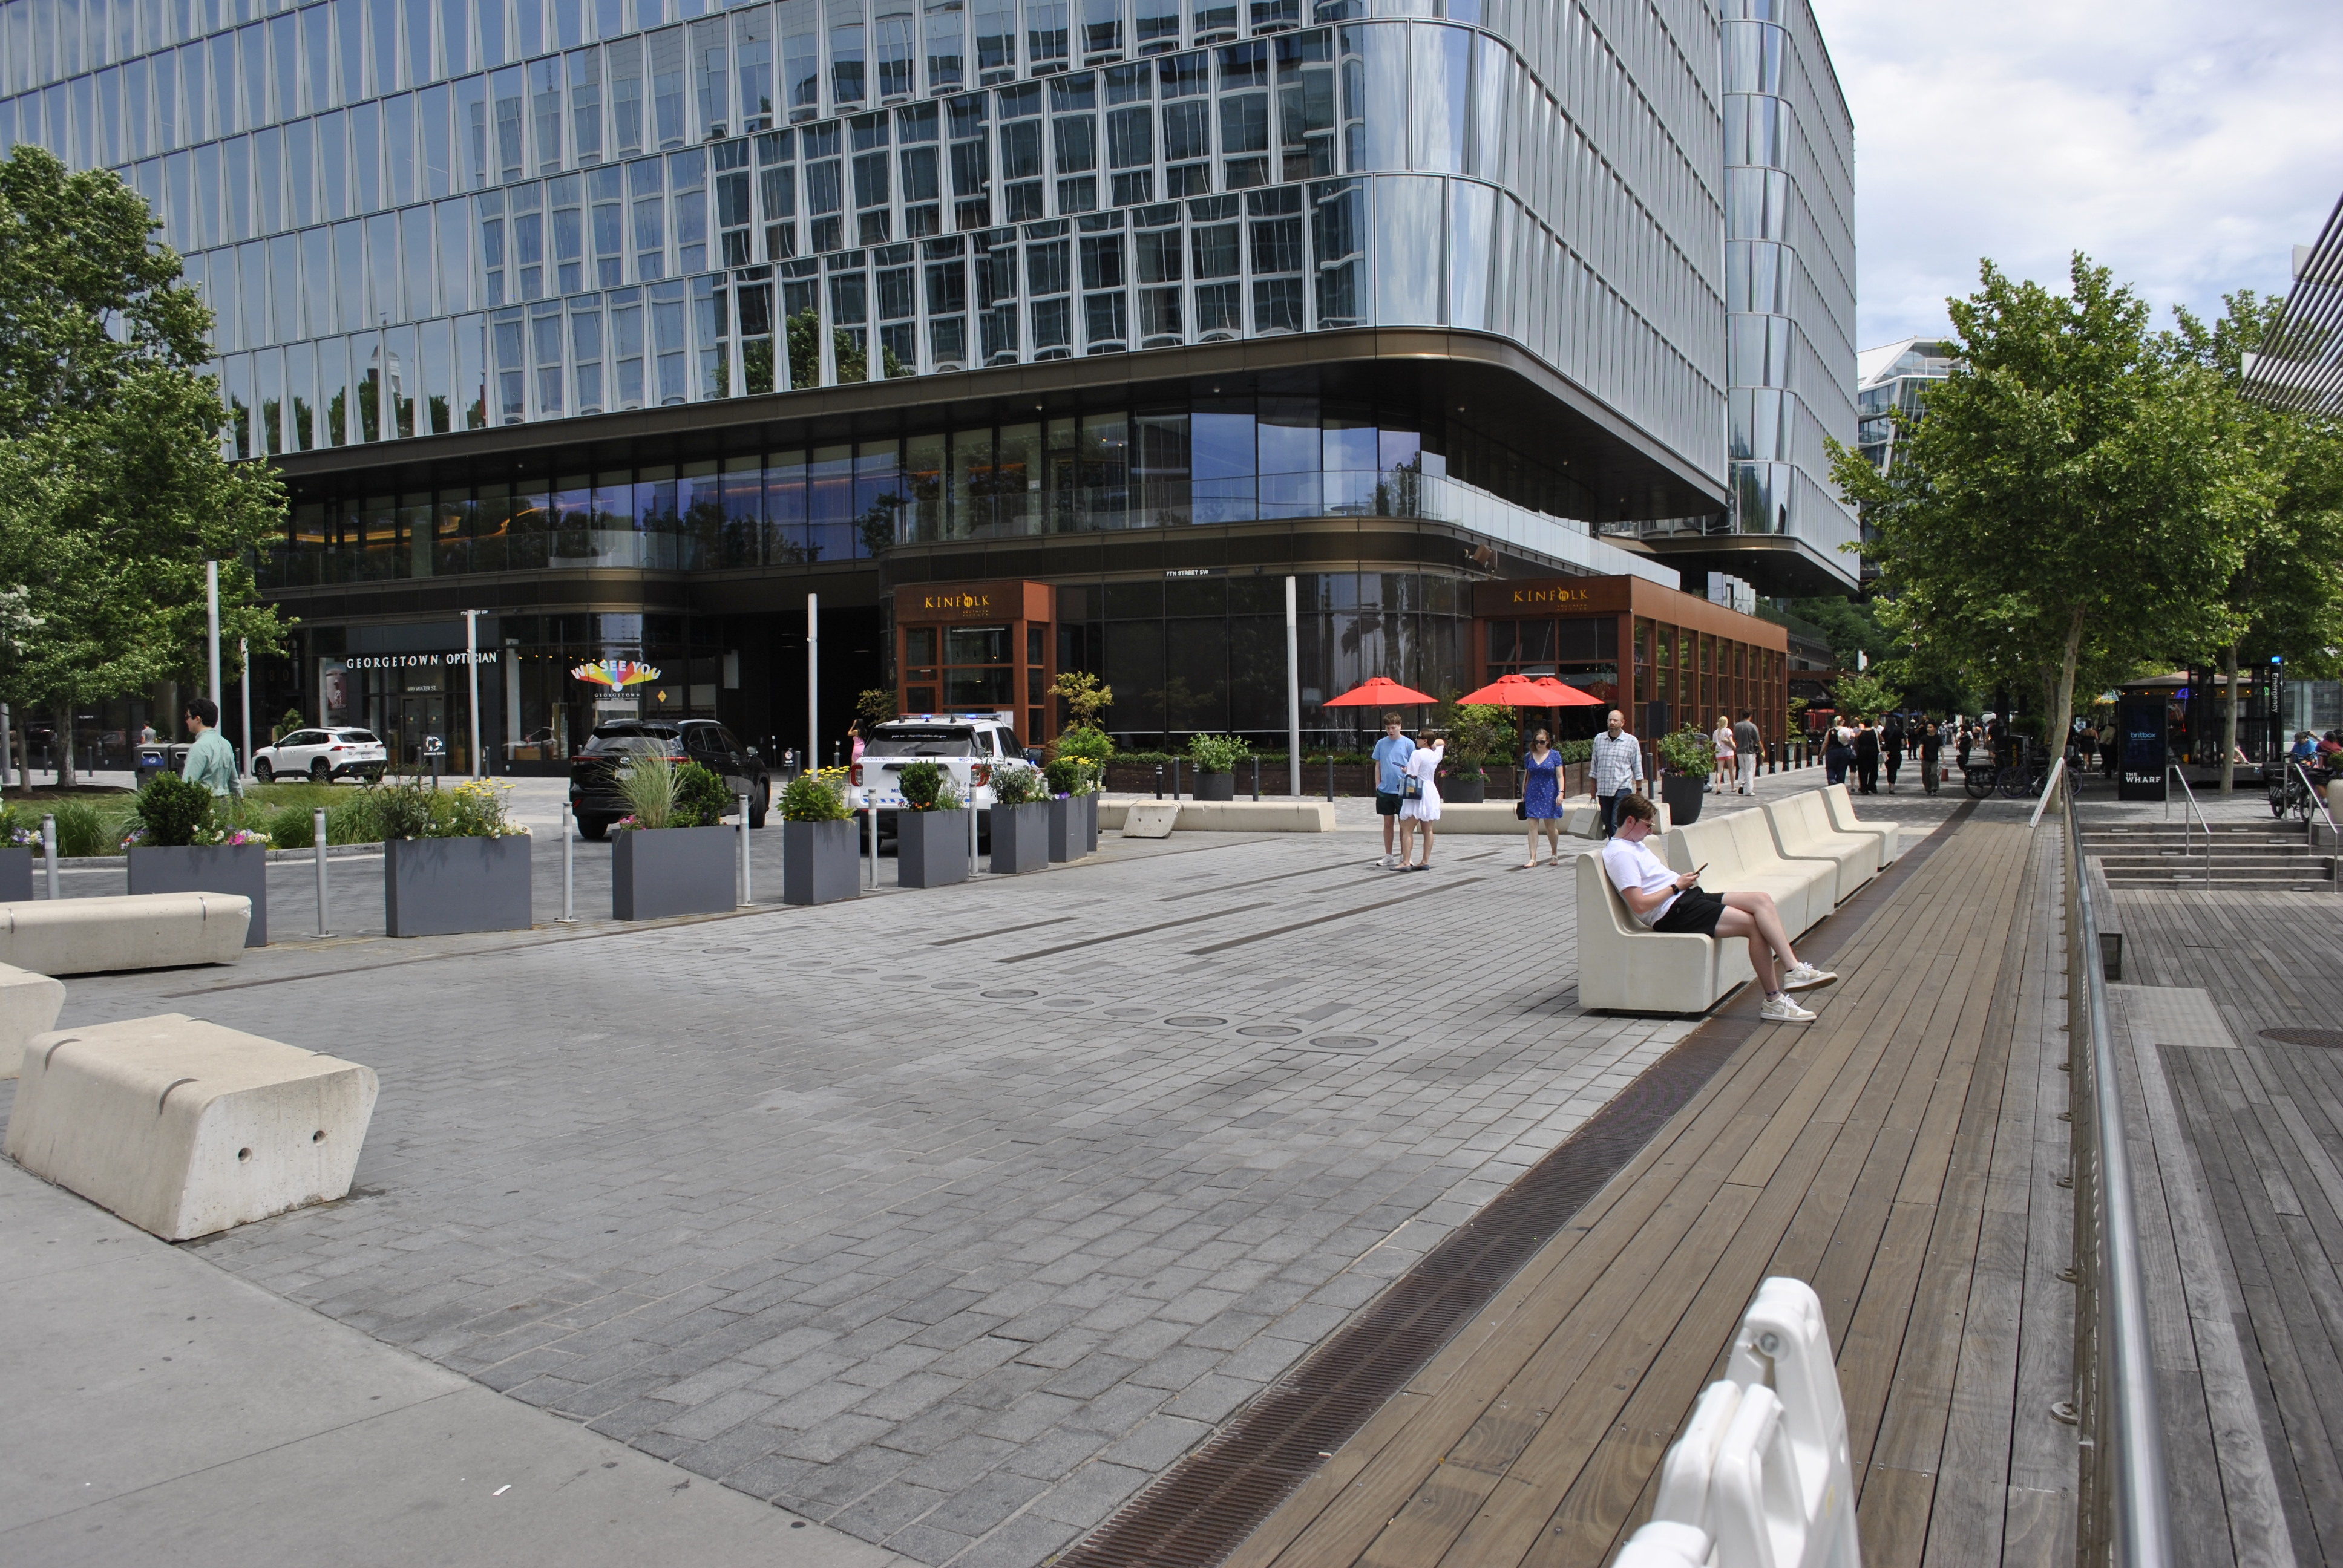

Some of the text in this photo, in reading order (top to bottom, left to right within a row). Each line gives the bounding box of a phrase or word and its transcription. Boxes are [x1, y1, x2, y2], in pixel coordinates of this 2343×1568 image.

[925, 592, 990, 608] KINFOLK
[1513, 586, 1588, 602] KINFOLK
[347, 655, 439, 669] GEORGETOWN
[571, 659, 661, 679] WE SEE YOU
